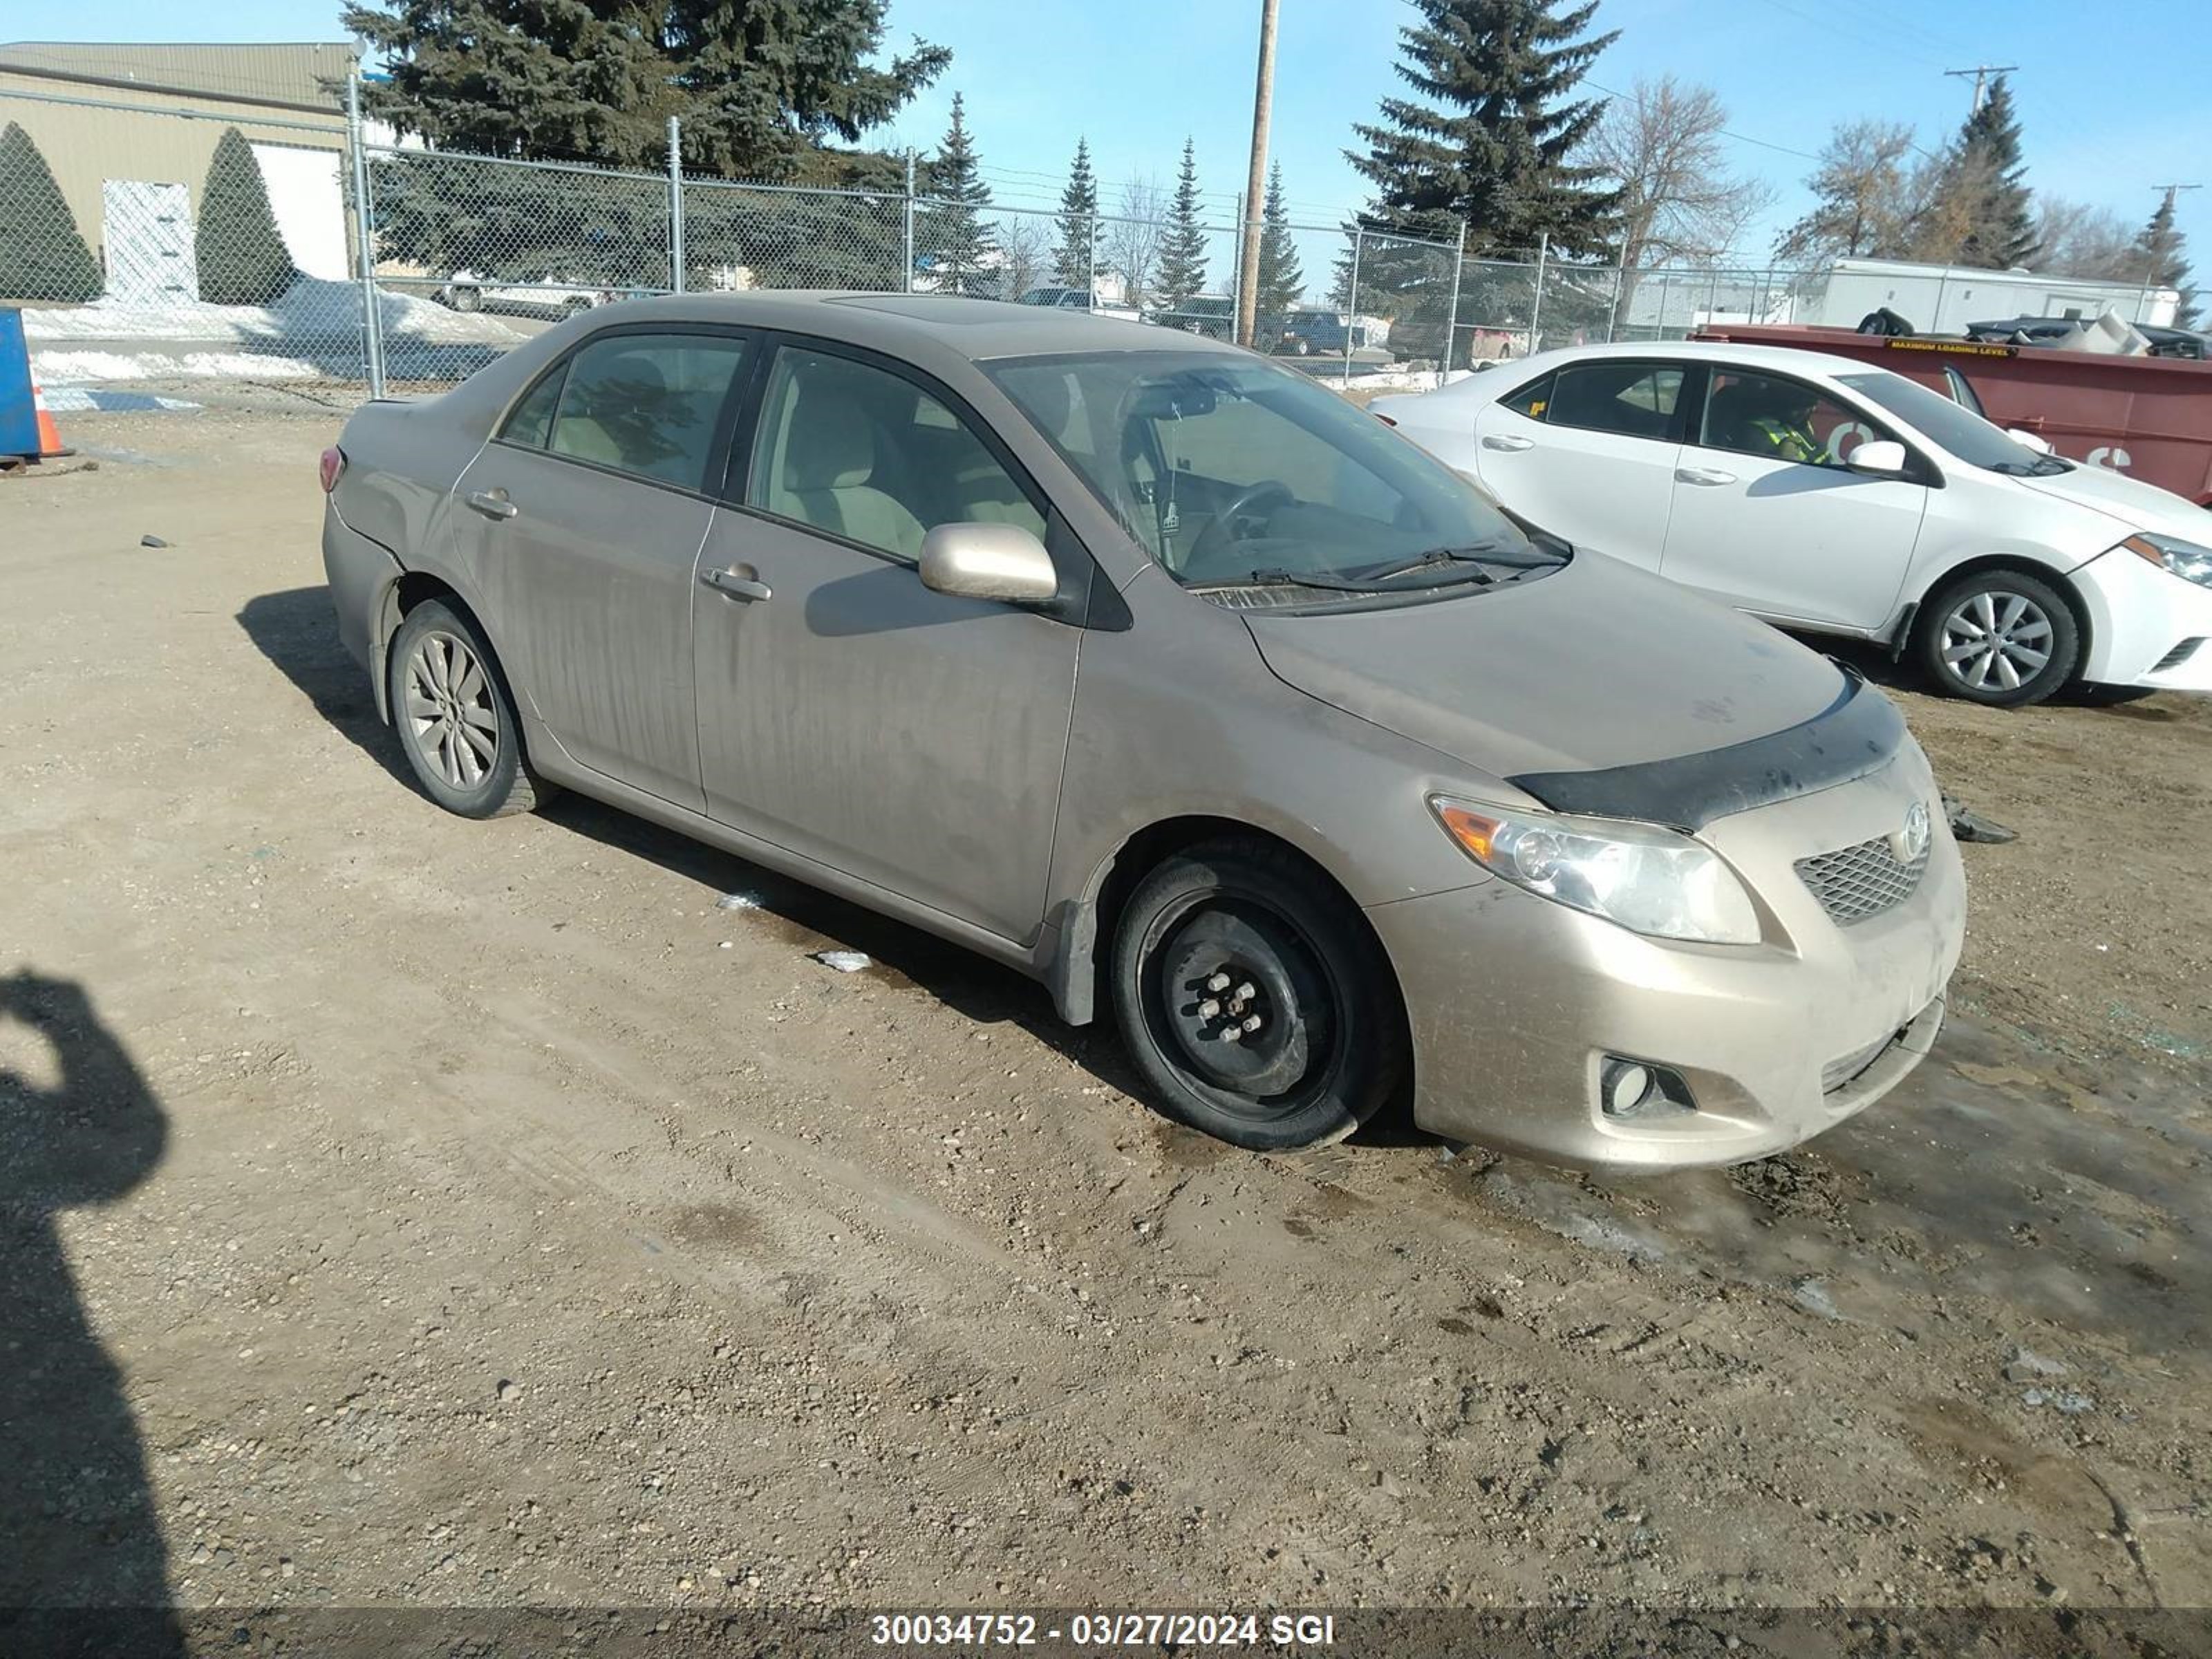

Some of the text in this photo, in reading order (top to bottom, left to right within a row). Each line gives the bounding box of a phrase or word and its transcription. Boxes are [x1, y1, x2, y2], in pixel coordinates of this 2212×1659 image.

[1891, 341, 2009, 357] MAXIMUM LOADING LEVEL
